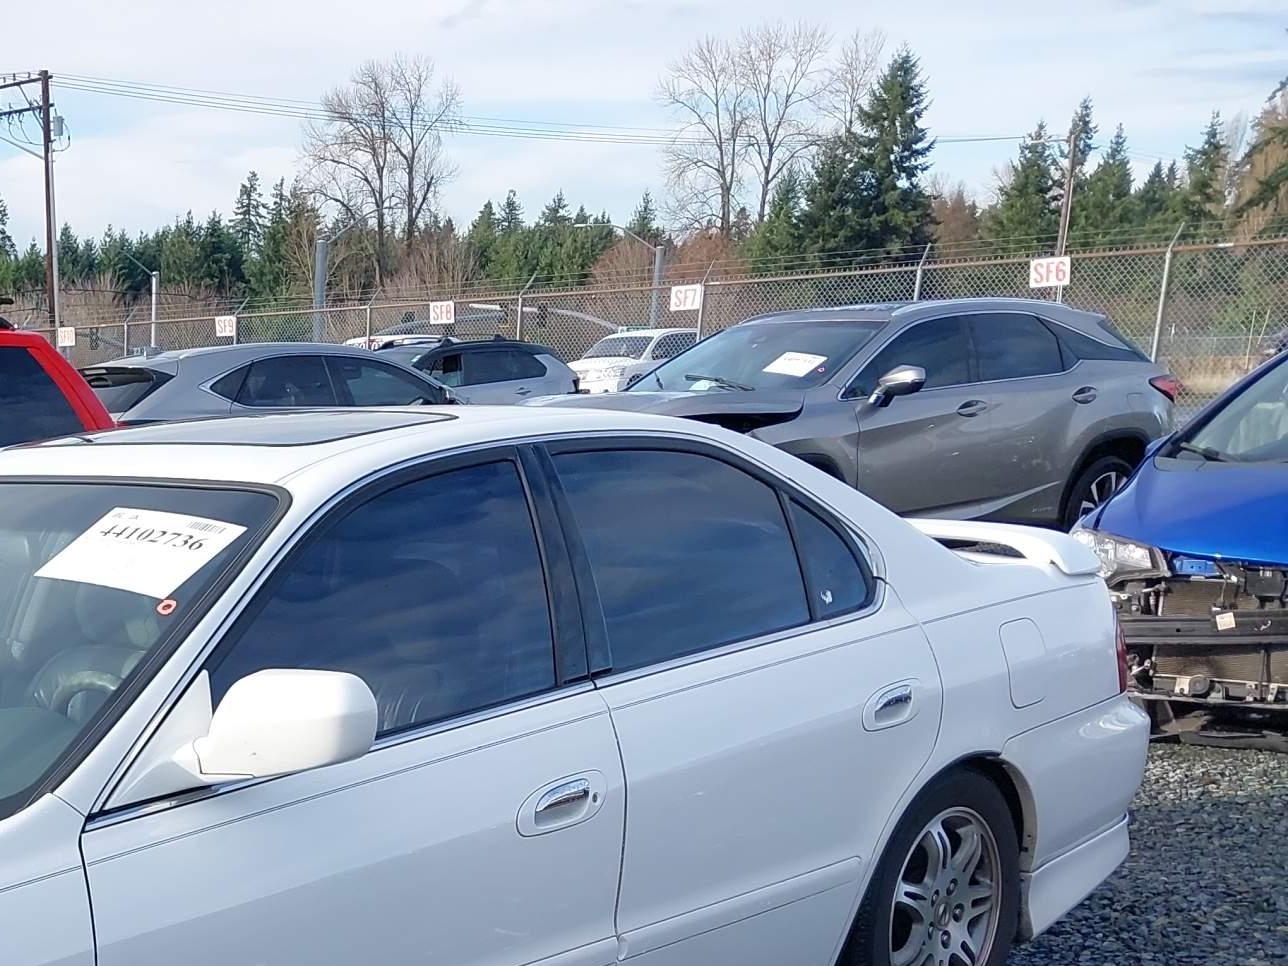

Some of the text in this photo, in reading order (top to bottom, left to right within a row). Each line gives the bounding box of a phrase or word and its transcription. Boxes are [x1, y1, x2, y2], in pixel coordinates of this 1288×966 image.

[1033, 260, 1067, 284] SF6
[674, 288, 697, 308] SF7
[432, 303, 452, 321] SF8
[217, 318, 234, 334] SF9
[100, 524, 208, 550] 44102736
